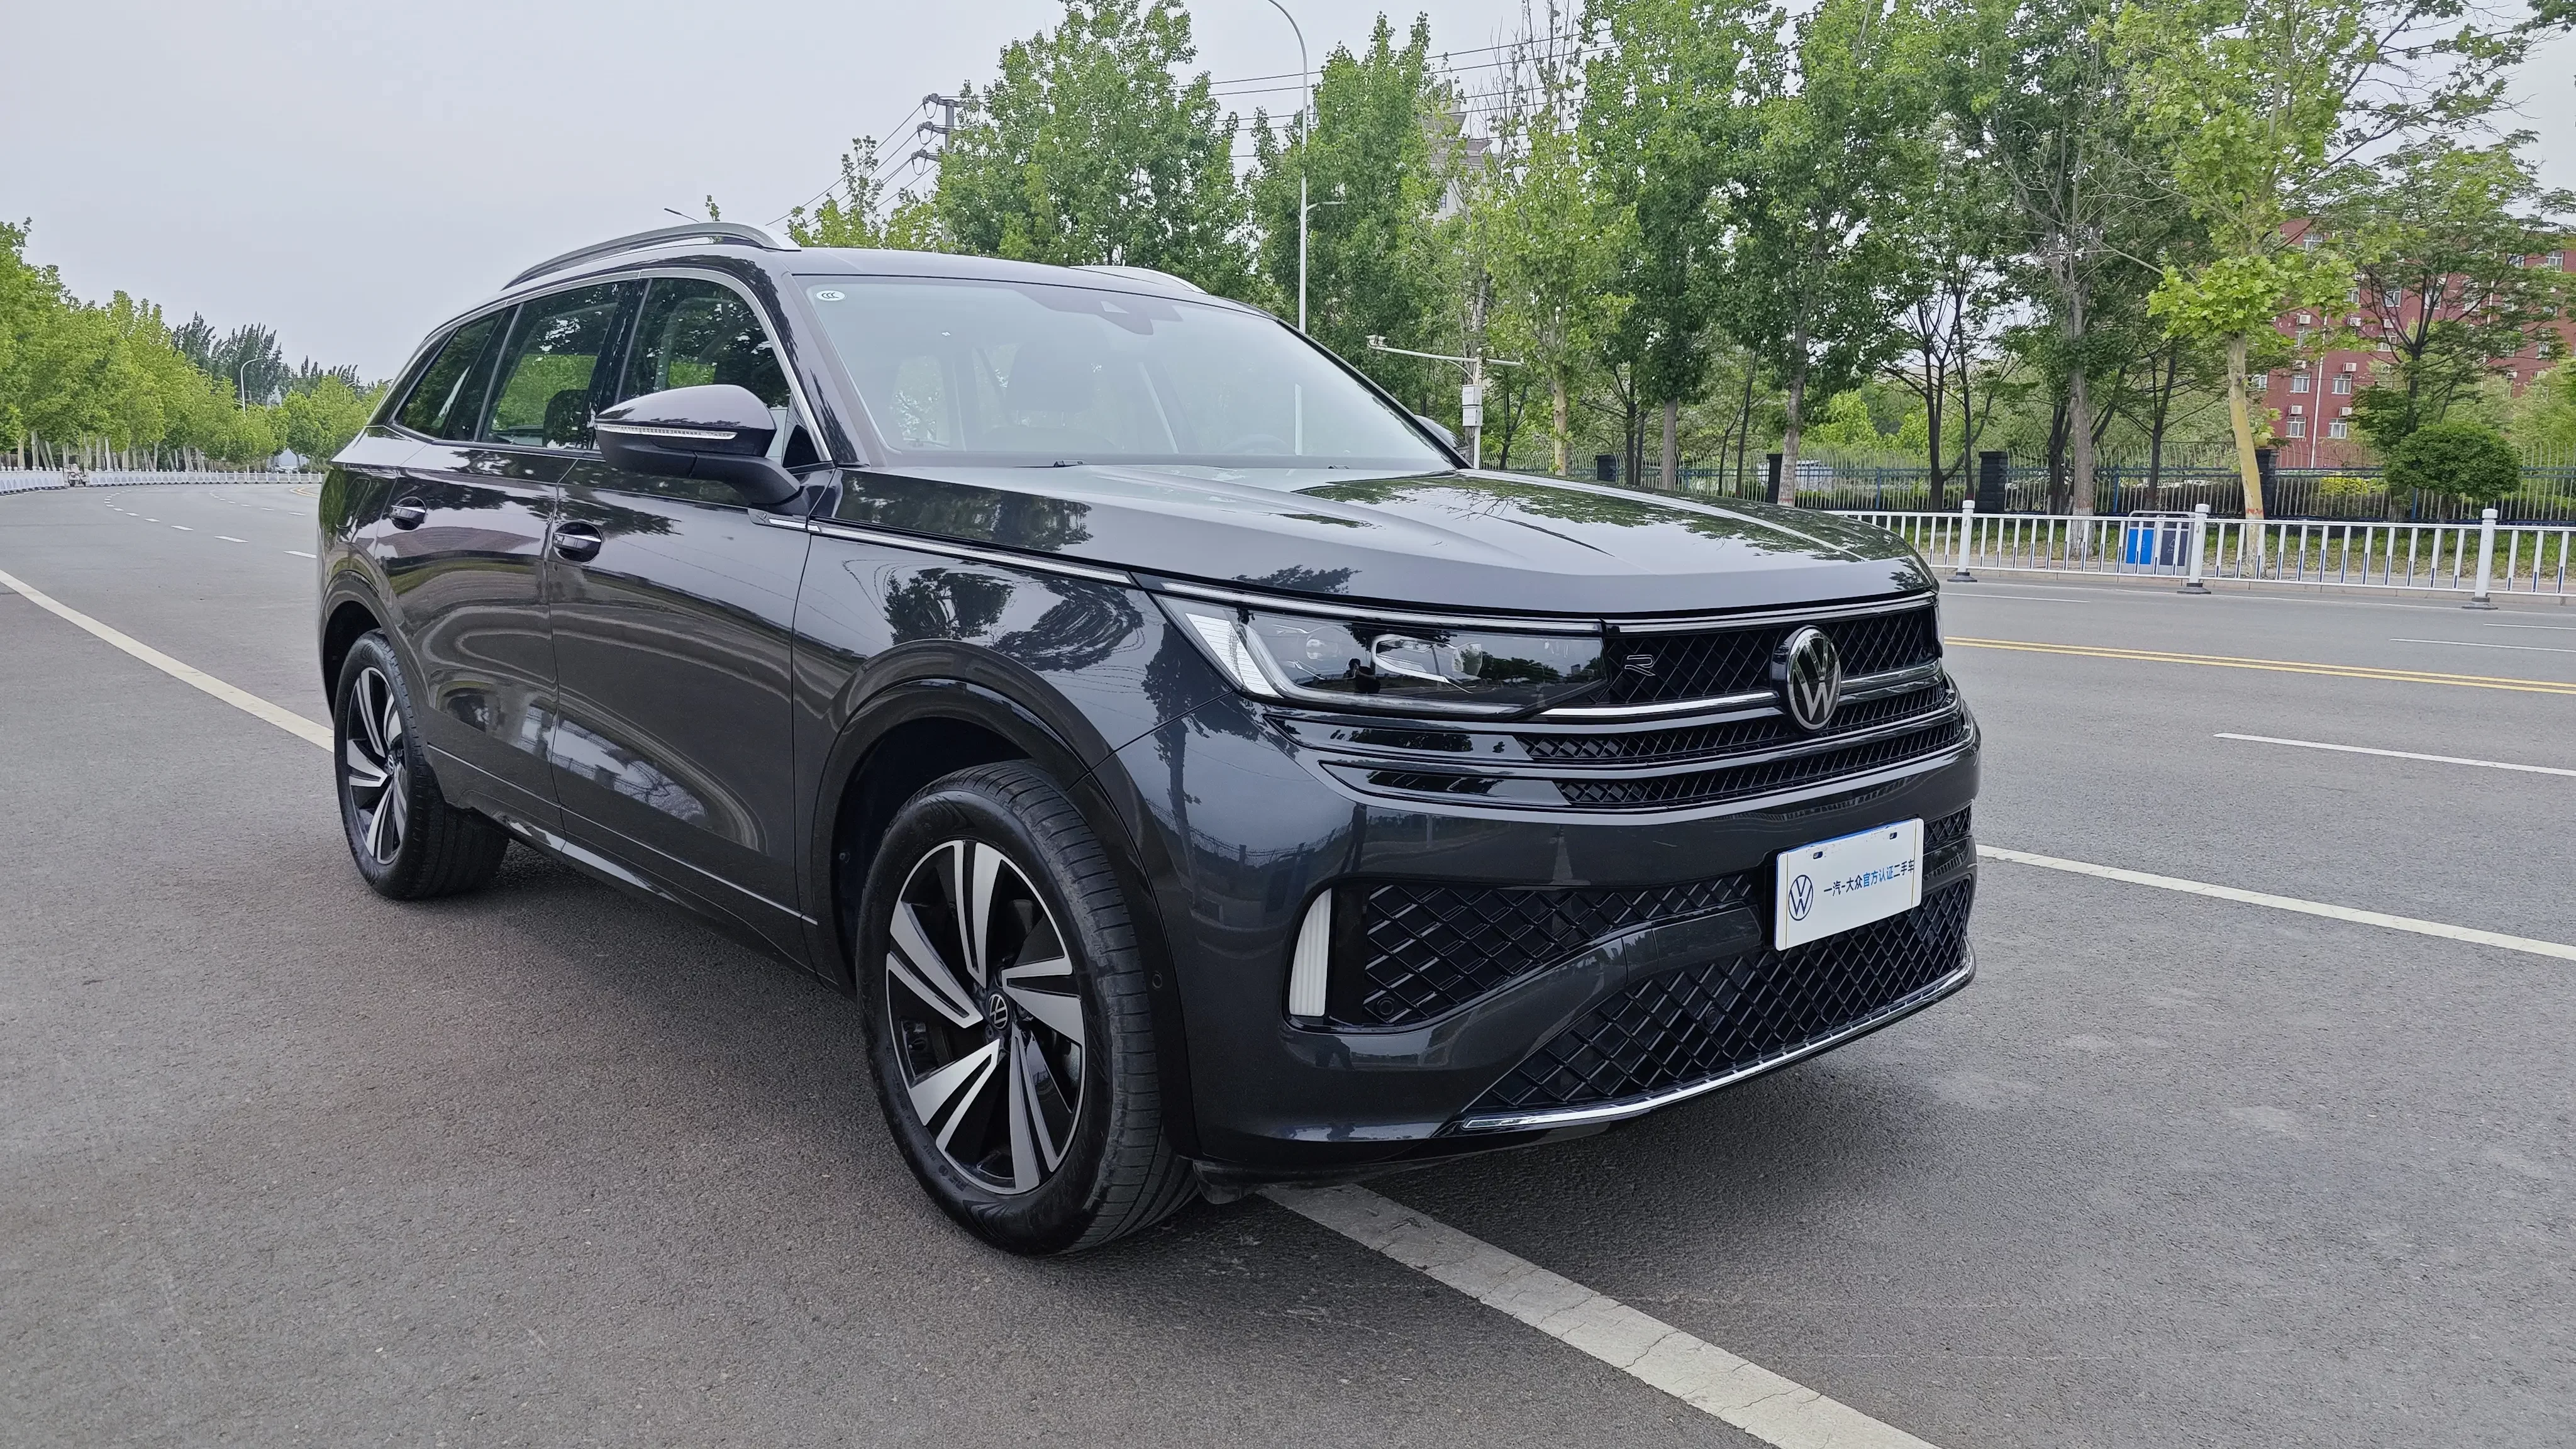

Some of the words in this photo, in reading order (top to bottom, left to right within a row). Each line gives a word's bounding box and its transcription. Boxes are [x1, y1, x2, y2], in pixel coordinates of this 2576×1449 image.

[1624, 654, 1656, 677] R
[1823, 858, 1915, 897] 一汽-大众官方认证二手车
[1788, 875, 1814, 921] VW
